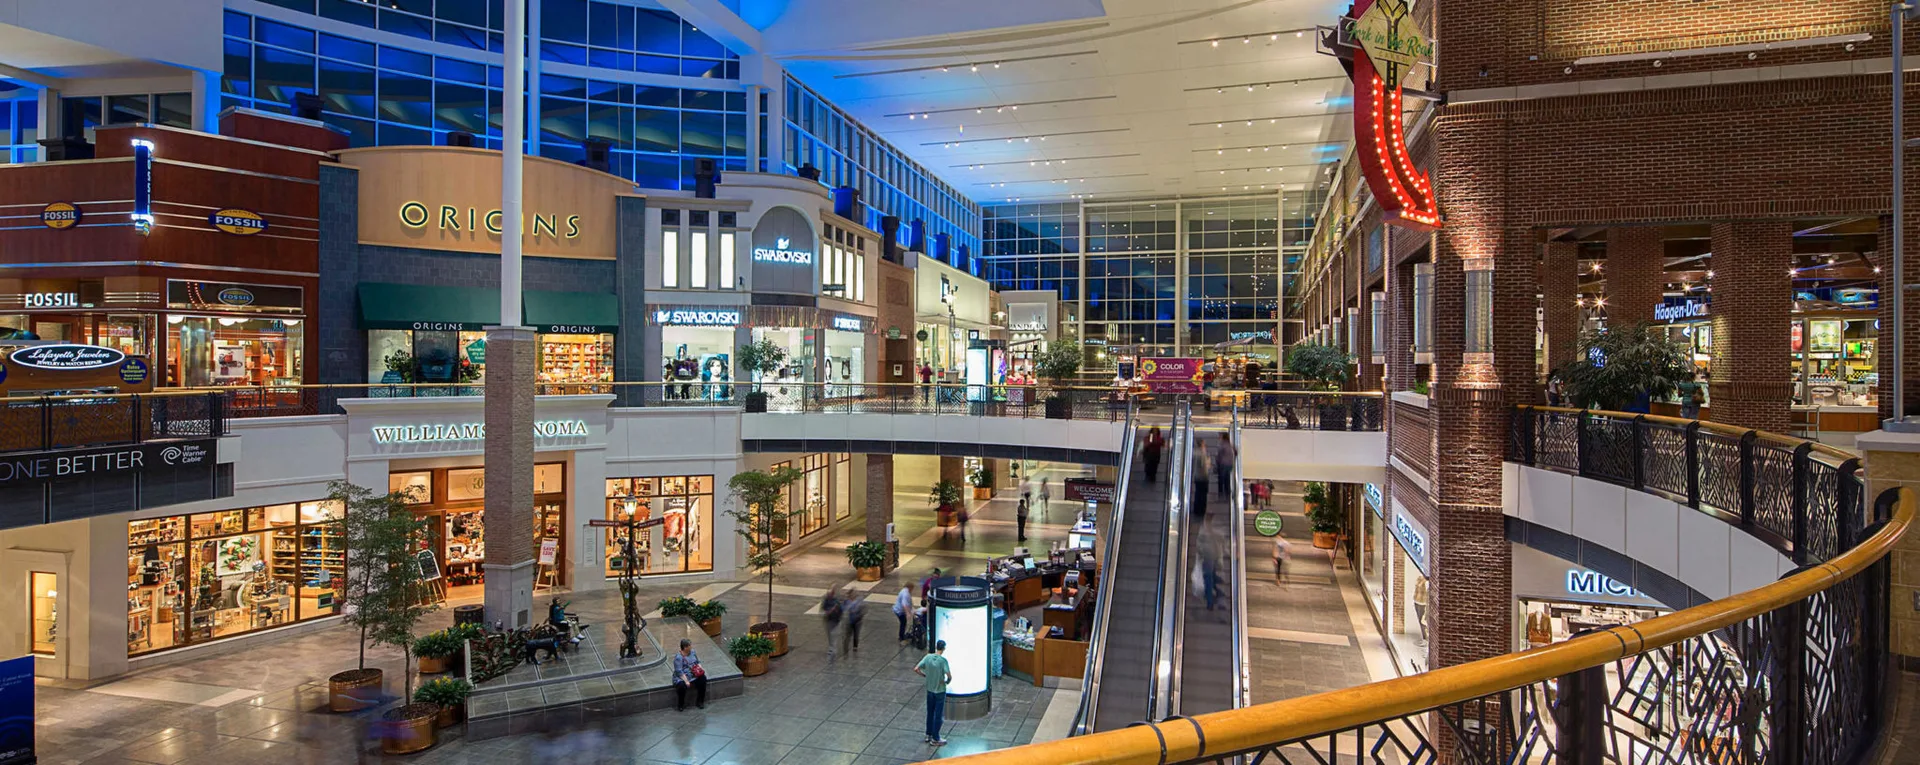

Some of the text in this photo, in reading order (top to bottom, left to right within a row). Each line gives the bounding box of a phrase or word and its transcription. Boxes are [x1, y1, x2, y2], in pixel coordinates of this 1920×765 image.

[1345, 20, 1371, 41] Fork
[1375, 31, 1385, 44] in
[1388, 32, 1403, 48] the
[1406, 36, 1434, 57] Road
[44, 211, 77, 220] FOSSIL
[215, 216, 265, 228] FOSSIL
[400, 202, 580, 238] ORIGNS
[754, 248, 812, 264] SWAROVSKI
[25, 292, 78, 307] FOSSIL
[672, 311, 740, 325] SWAROVSKI
[1654, 299, 1706, 324] Häagen-Da
[413, 322, 463, 331] ORIGINS
[551, 325, 596, 333] ORIGINS
[28, 348, 110, 361] Lafayette Jewelers
[534, 420, 588, 436] NOMA
[182, 450, 207, 458] Warner
[182, 456, 201, 464] Cable
[0, 450, 144, 481] ONE BETTER
[1074, 486, 1114, 494] WELCOME
[1570, 572, 1636, 596] MIC
[945, 591, 979, 599] DIRECTORY
